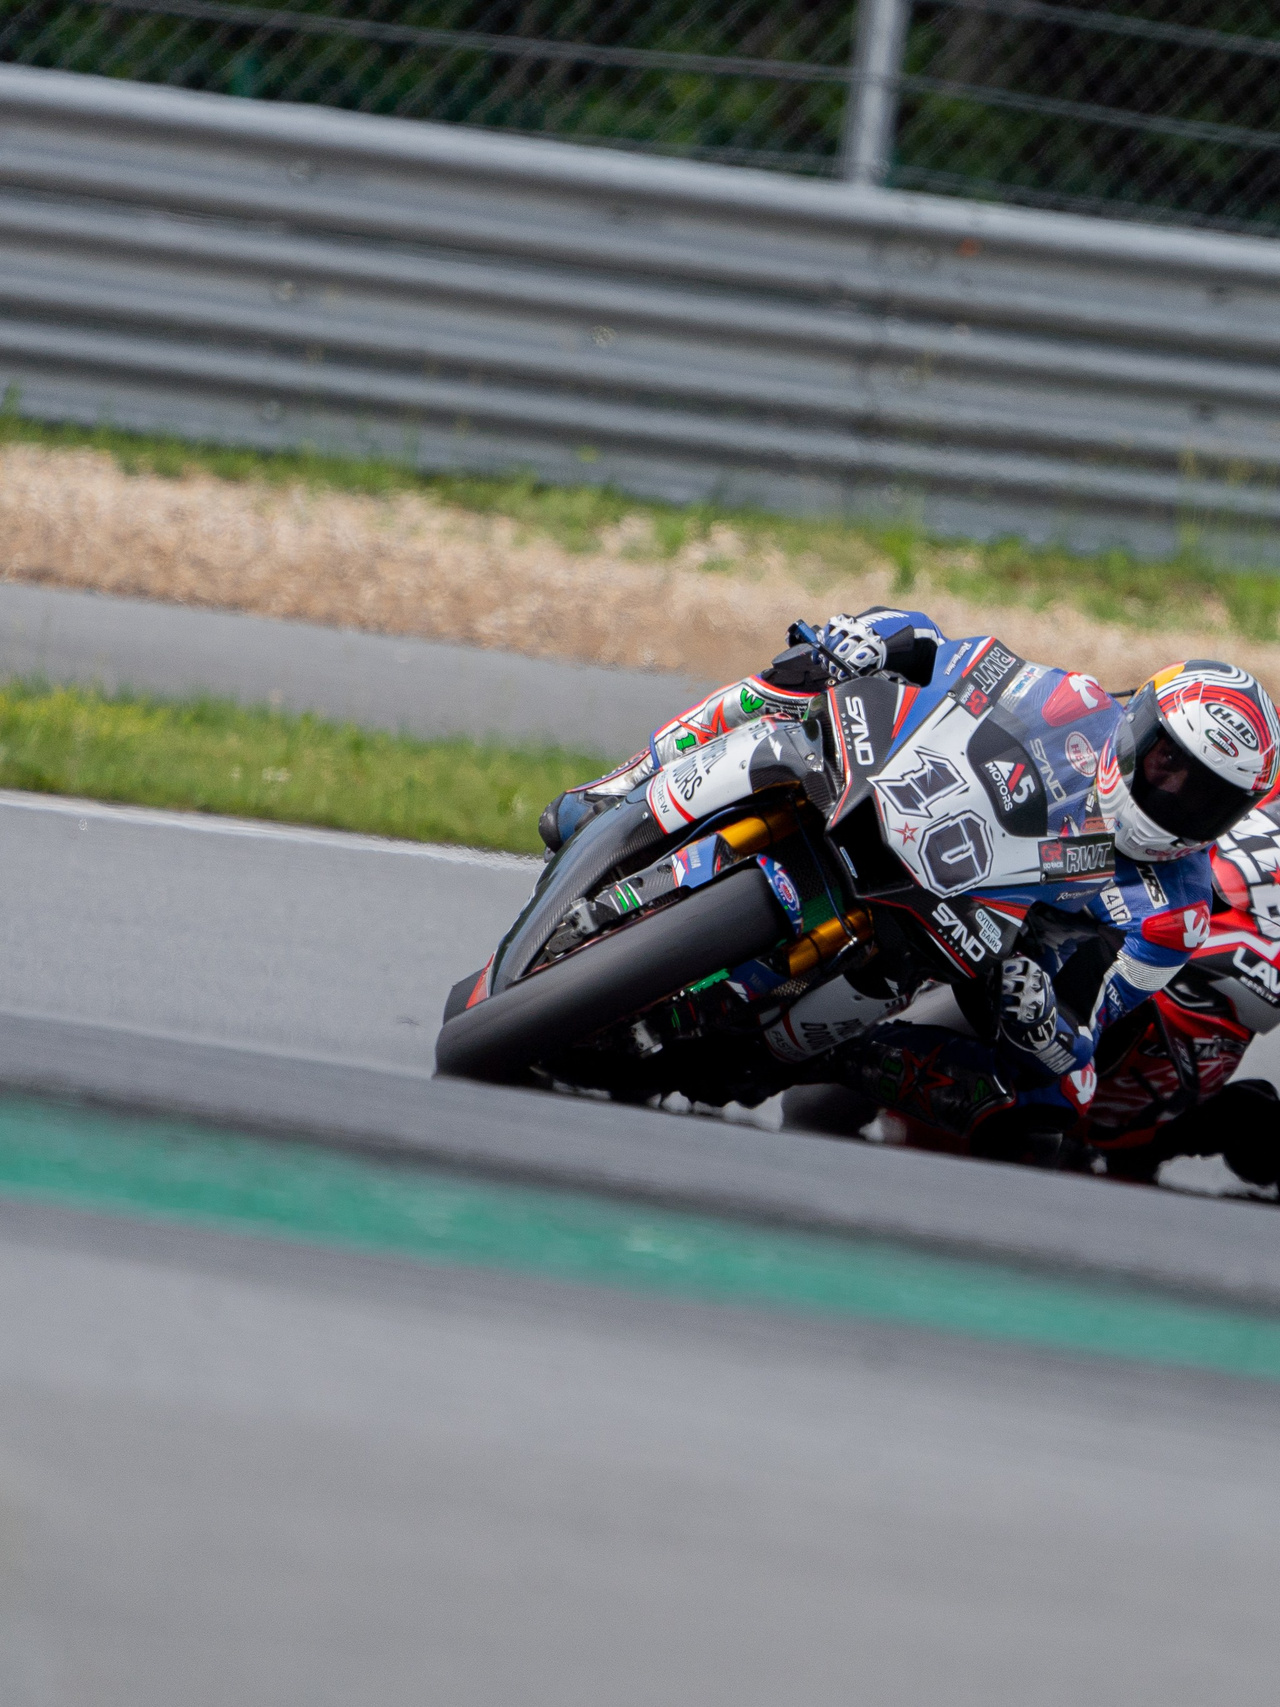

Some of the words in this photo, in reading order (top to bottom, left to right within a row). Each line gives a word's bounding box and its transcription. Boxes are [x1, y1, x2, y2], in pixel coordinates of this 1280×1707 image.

[972, 647, 1016, 695] RWT
[841, 713, 852, 750] PARTS
[845, 695, 874, 766] SAND
[1212, 707, 1256, 744] HJC
[985, 762, 1013, 812] MOTORS
[1066, 842, 1112, 873] RWT
[932, 902, 986, 962] SAND
[977, 909, 1001, 936] СУПЕР
[980, 928, 1001, 951] БАЙК
